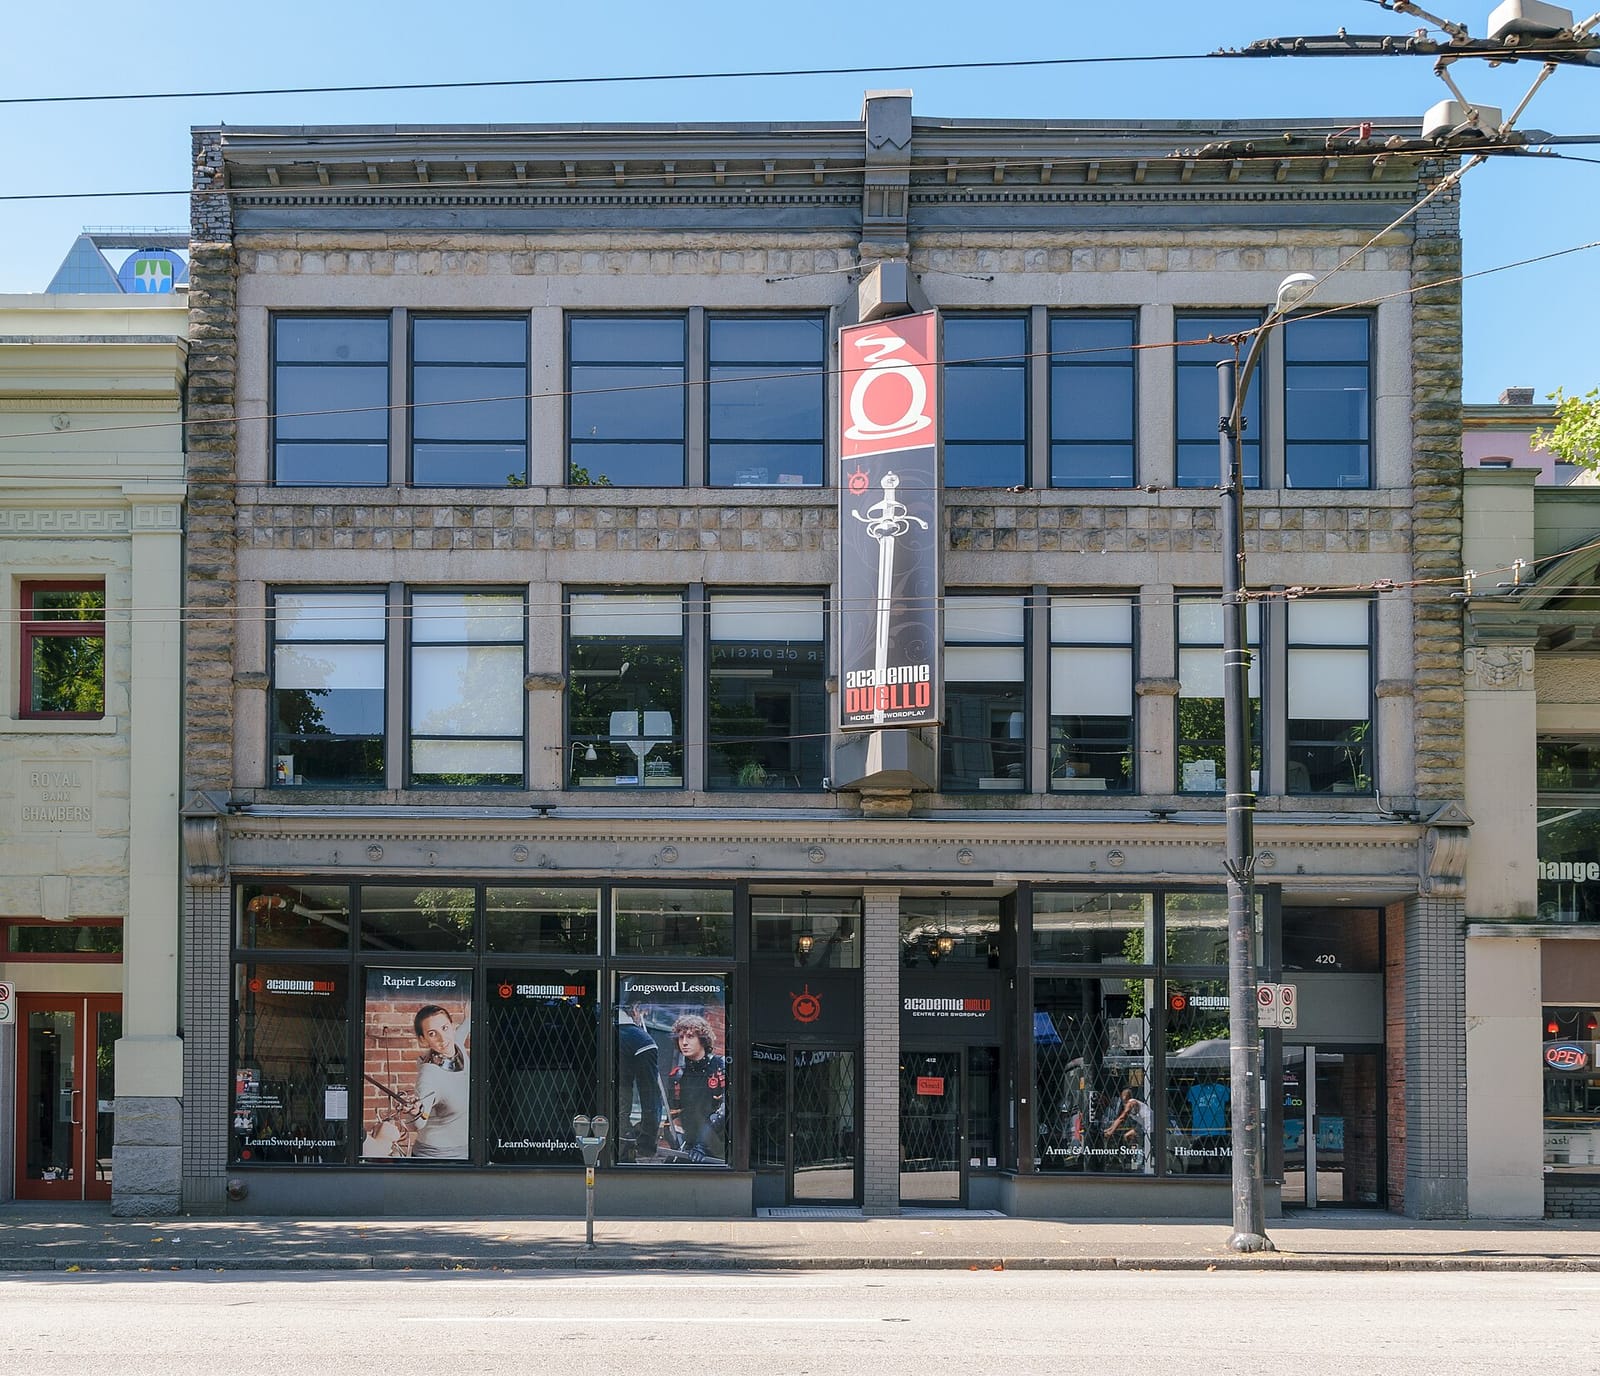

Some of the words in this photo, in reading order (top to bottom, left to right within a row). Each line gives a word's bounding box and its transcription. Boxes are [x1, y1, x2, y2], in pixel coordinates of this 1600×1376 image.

[31, 772, 81, 788] ROYAL
[42, 791, 70, 801] BANK
[22, 806, 90, 821] CHAMBERS
[1315, 954, 1336, 964] 420
[382, 975, 416, 989] Rapier
[417, 976, 457, 987] Lessons
[624, 982, 680, 995] Longsword
[681, 982, 721, 993] Lessons
[1545, 1048, 1587, 1066] OPEN
[245, 1136, 336, 1149] LearnSwordplay.com
[1046, 1146, 1070, 1155] Arms
[1072, 1145, 1083, 1155] &
[1083, 1146, 1118, 1155] Armour
[1120, 1146, 1143, 1155] Store
[1174, 1146, 1218, 1157] Historical
